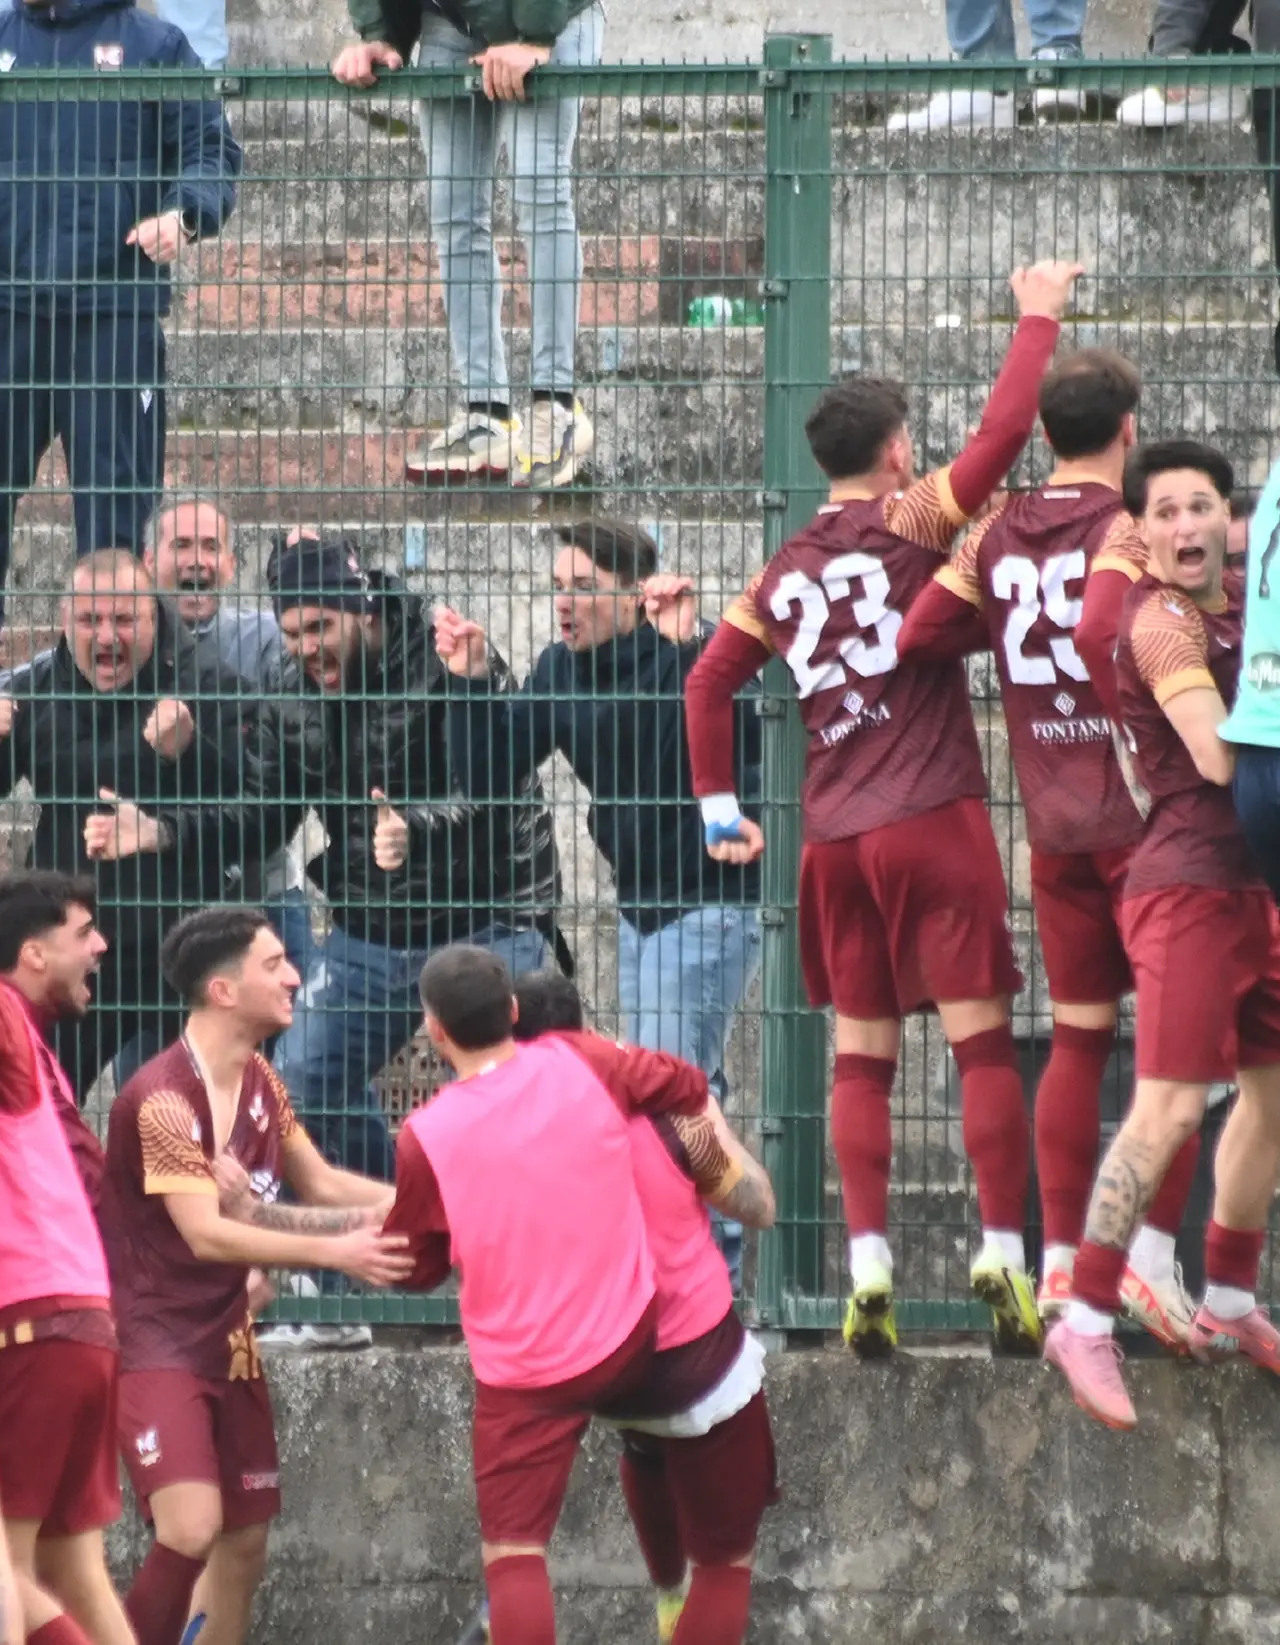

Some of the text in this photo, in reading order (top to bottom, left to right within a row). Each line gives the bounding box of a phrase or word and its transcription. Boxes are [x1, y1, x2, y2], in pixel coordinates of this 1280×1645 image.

[770, 553, 904, 700] 23
[992, 549, 1090, 685] 25
[820, 703, 892, 746] FONNA
[1031, 718, 1111, 741] FONTANA
